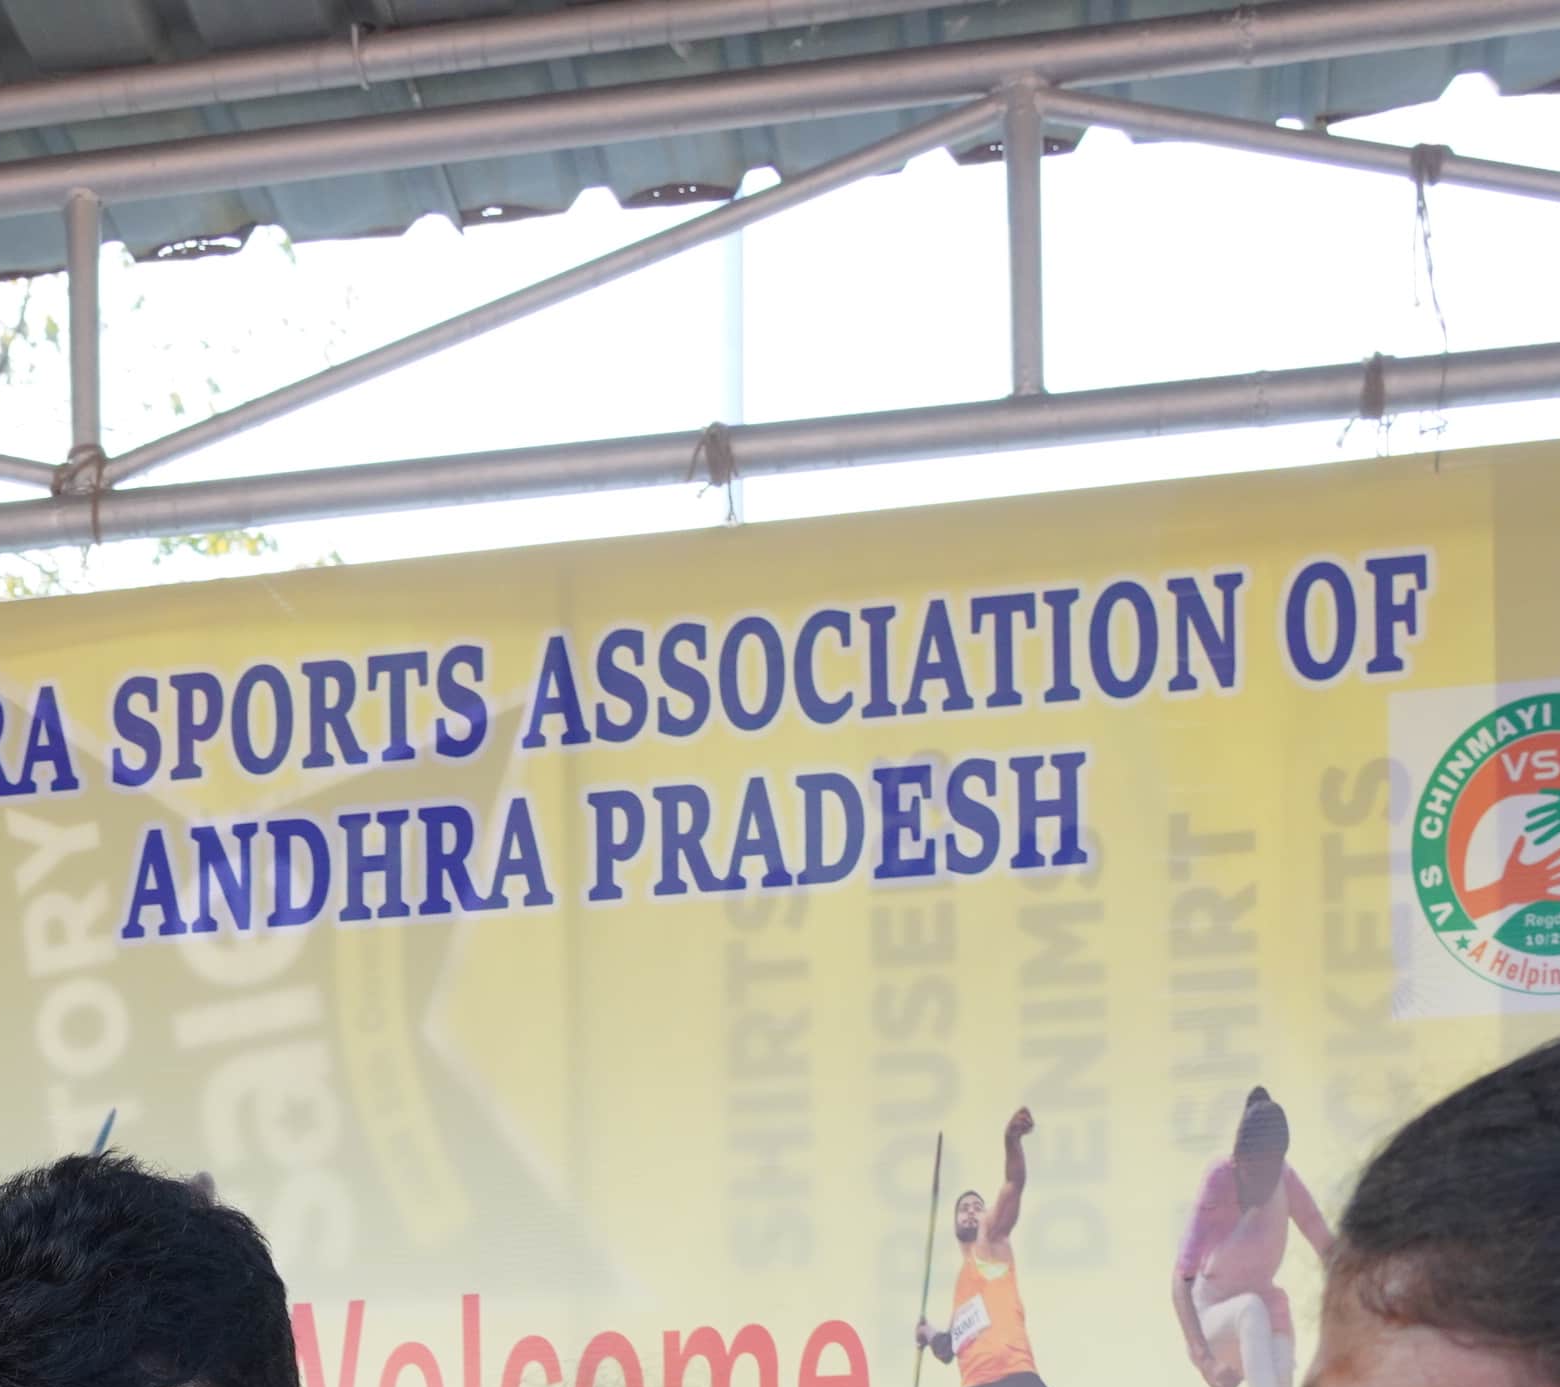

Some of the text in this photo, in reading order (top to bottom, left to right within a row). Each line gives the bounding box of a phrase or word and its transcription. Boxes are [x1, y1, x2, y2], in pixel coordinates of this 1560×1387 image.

[111, 645, 489, 789] SPORTS
[520, 572, 1244, 750] ASSOCIATION
[1286, 554, 1429, 681] OF
[1418, 702, 1554, 841] CHINMAYI
[119, 751, 1089, 941] ANDHRA PRADESH
[1420, 864, 1444, 889] S
[1429, 901, 1455, 928] V
[1467, 939, 1491, 964] A
